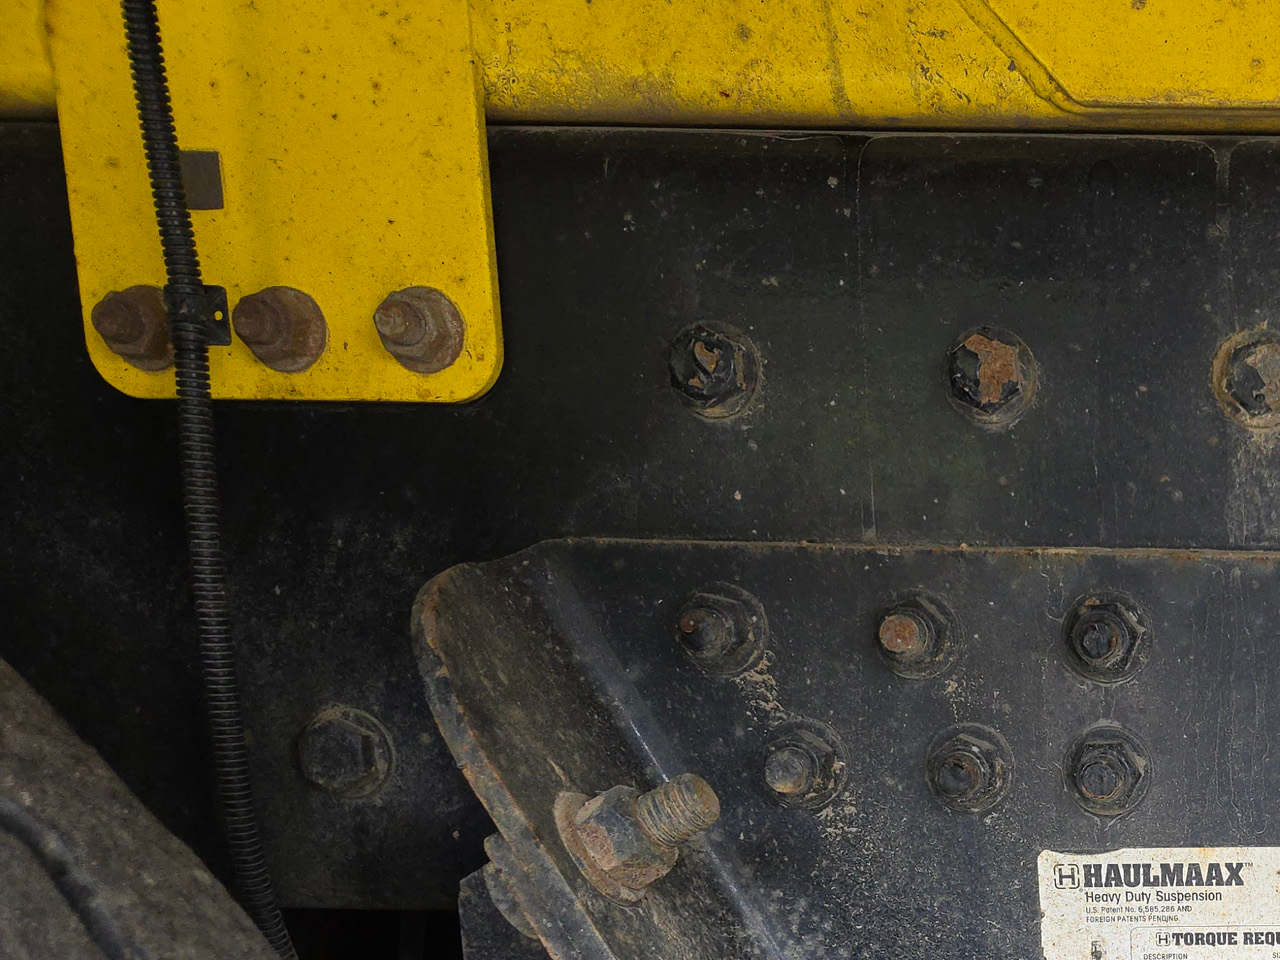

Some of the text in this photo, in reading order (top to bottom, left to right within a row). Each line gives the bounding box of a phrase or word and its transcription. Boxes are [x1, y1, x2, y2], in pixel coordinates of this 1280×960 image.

[1085, 889, 1222, 905] Heavy Duty Suspension
[1101, 906, 1123, 914] Patent
[1176, 905, 1193, 913] AND
[1086, 915, 1181, 923] FOREIGN PATENTS PENDING.
[1172, 931, 1238, 947] TORQUE
